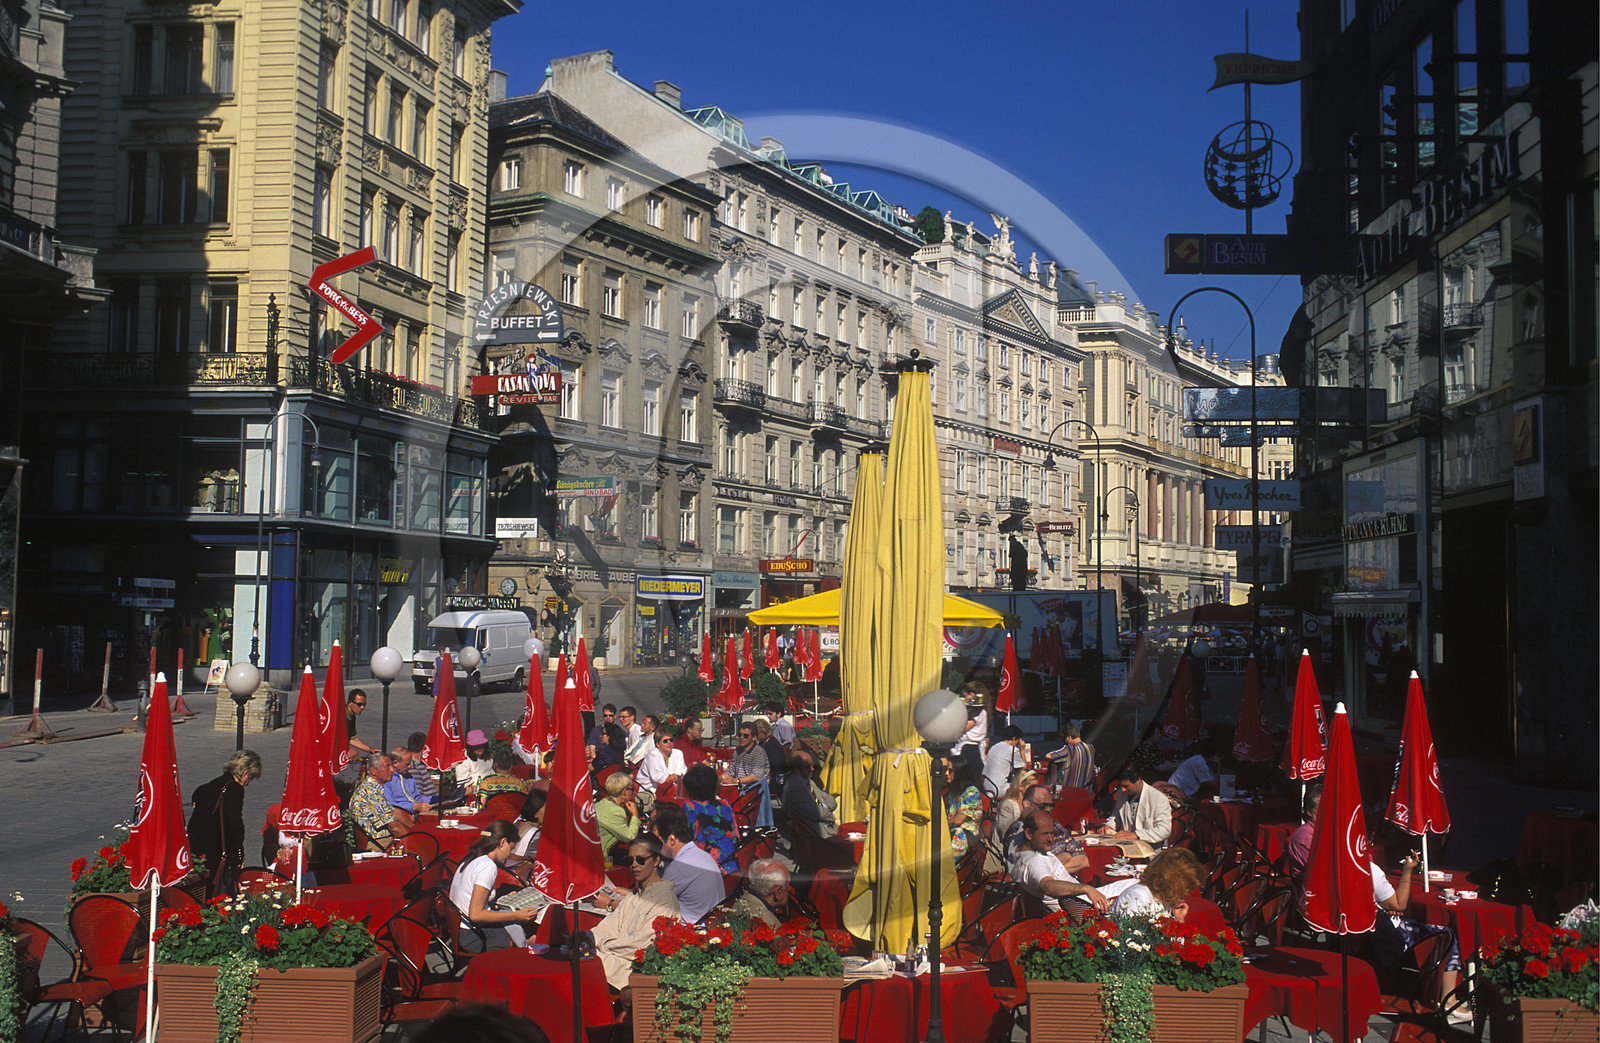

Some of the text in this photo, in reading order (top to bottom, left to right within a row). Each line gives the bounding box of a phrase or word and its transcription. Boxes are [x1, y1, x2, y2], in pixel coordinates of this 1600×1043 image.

[1223, 63, 1297, 75] TEPPICHE
[1229, 236, 1267, 251] ADIL
[1210, 242, 1267, 264] BESIM
[491, 316, 543, 329] BUFFET
[498, 373, 556, 393] CASANOVA
[503, 395, 557, 404] REVUE BAR
[1213, 486, 1242, 505] Yves
[770, 560, 808, 571] EDUSCHO
[279, 807, 322, 828] Coca-Cola
